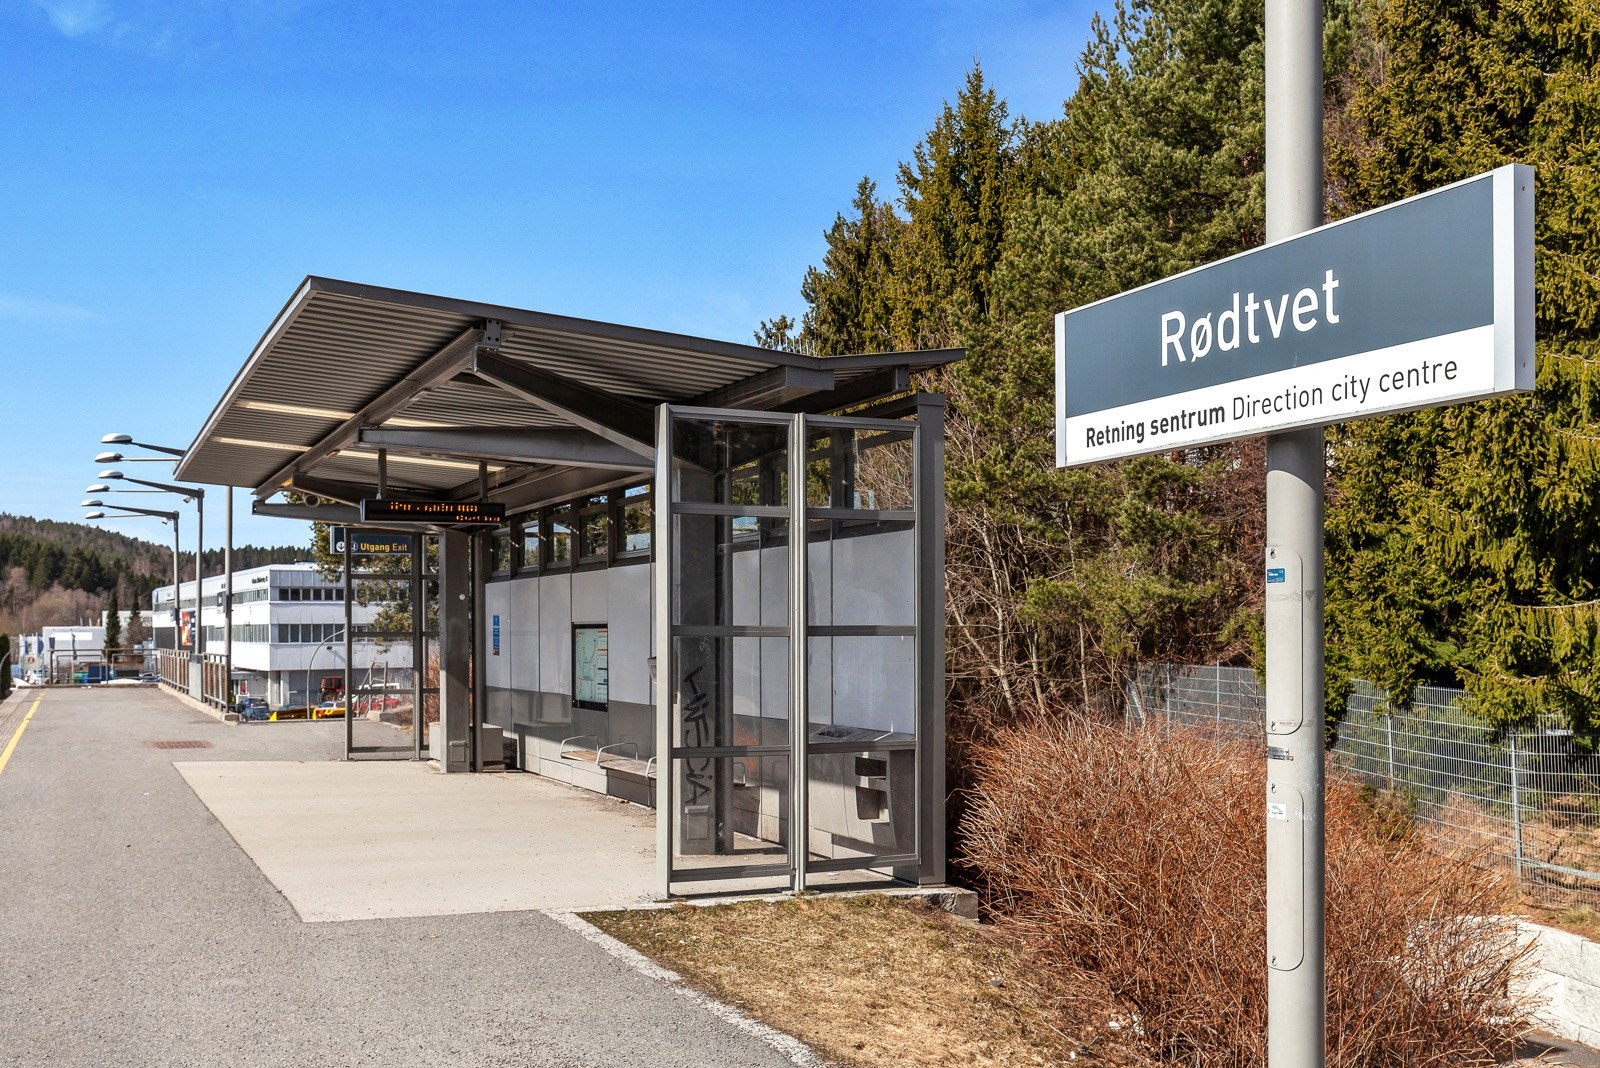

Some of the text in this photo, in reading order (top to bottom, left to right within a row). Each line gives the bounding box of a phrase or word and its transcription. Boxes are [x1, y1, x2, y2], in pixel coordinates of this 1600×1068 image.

[1161, 268, 1340, 367] Rødtvet
[1086, 360, 1458, 448] Retning sentrum Direction city centre
[360, 542, 408, 553] Utgang Exit
